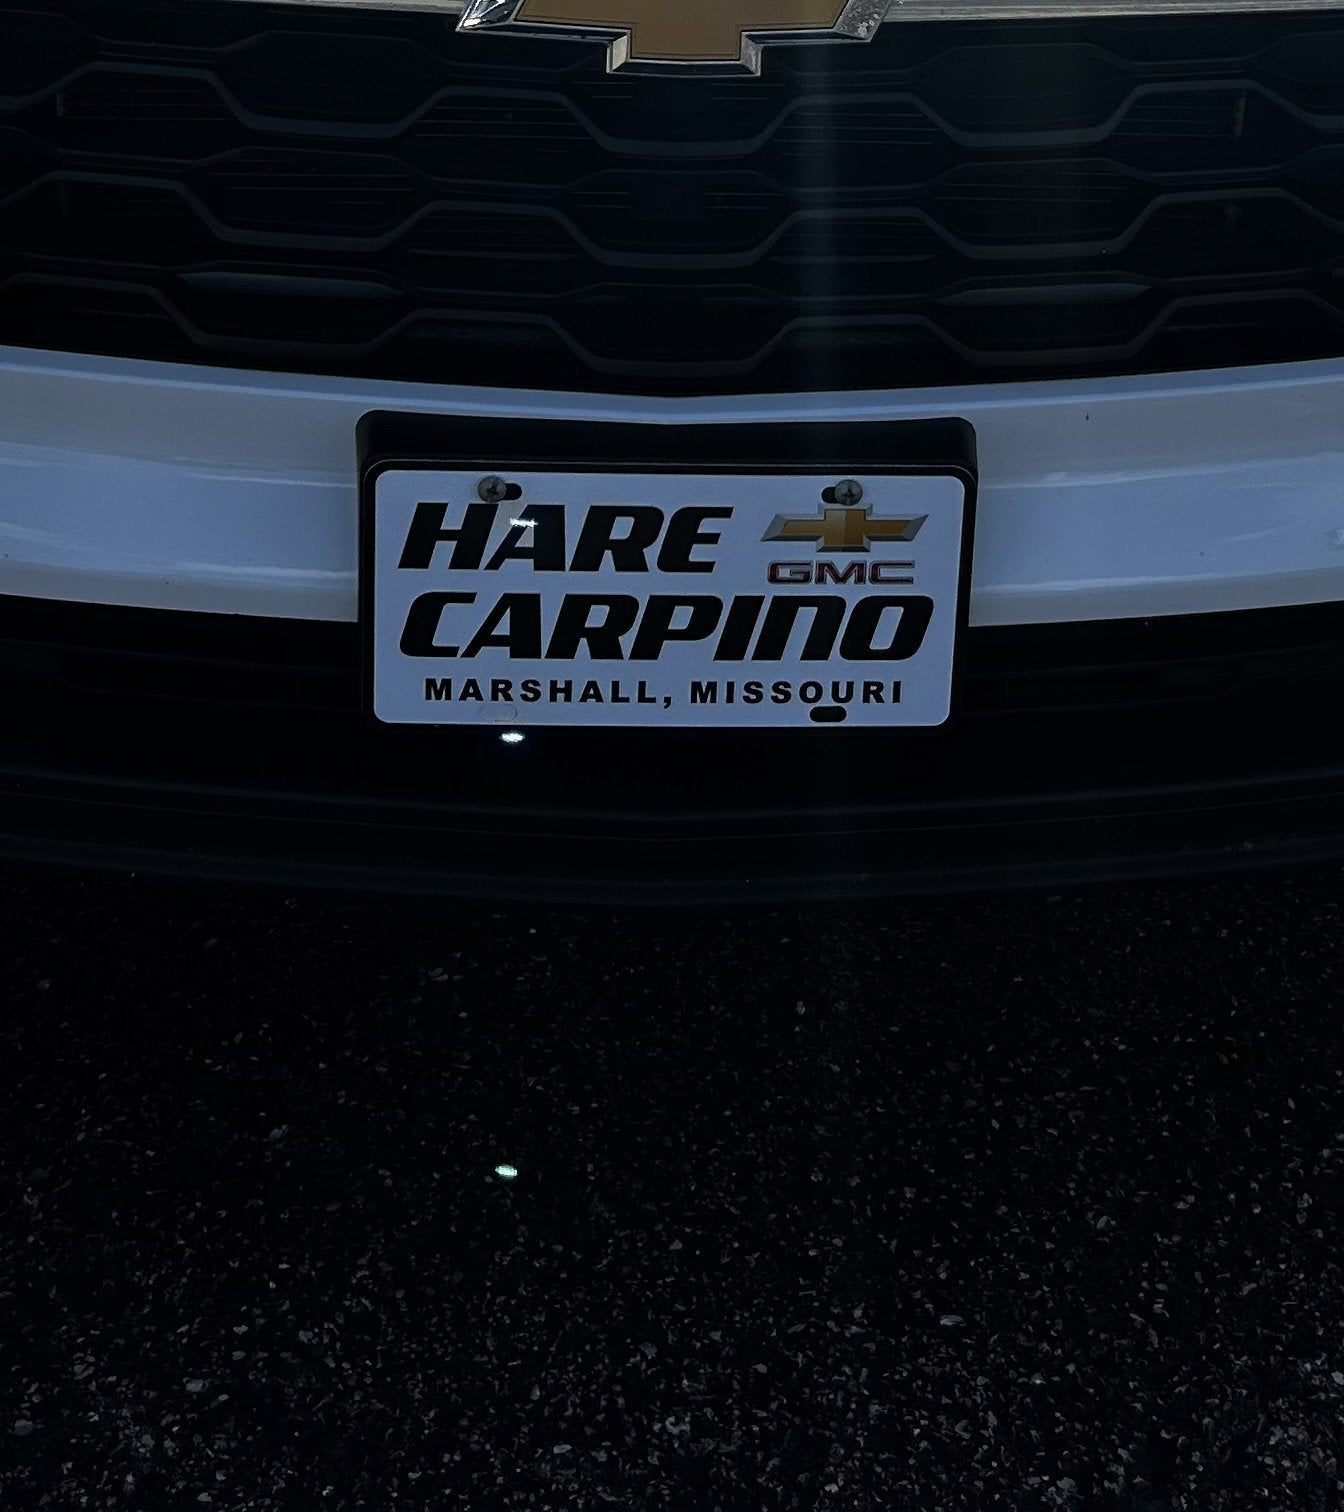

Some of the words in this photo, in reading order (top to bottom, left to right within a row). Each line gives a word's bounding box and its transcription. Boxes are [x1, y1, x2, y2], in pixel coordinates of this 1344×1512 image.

[398, 502, 734, 573] HARE
[766, 560, 916, 586] GMC
[398, 591, 935, 662] CARPINO
[424, 678, 673, 710] MARSHALL,
[689, 680, 903, 705] MISSOURI
